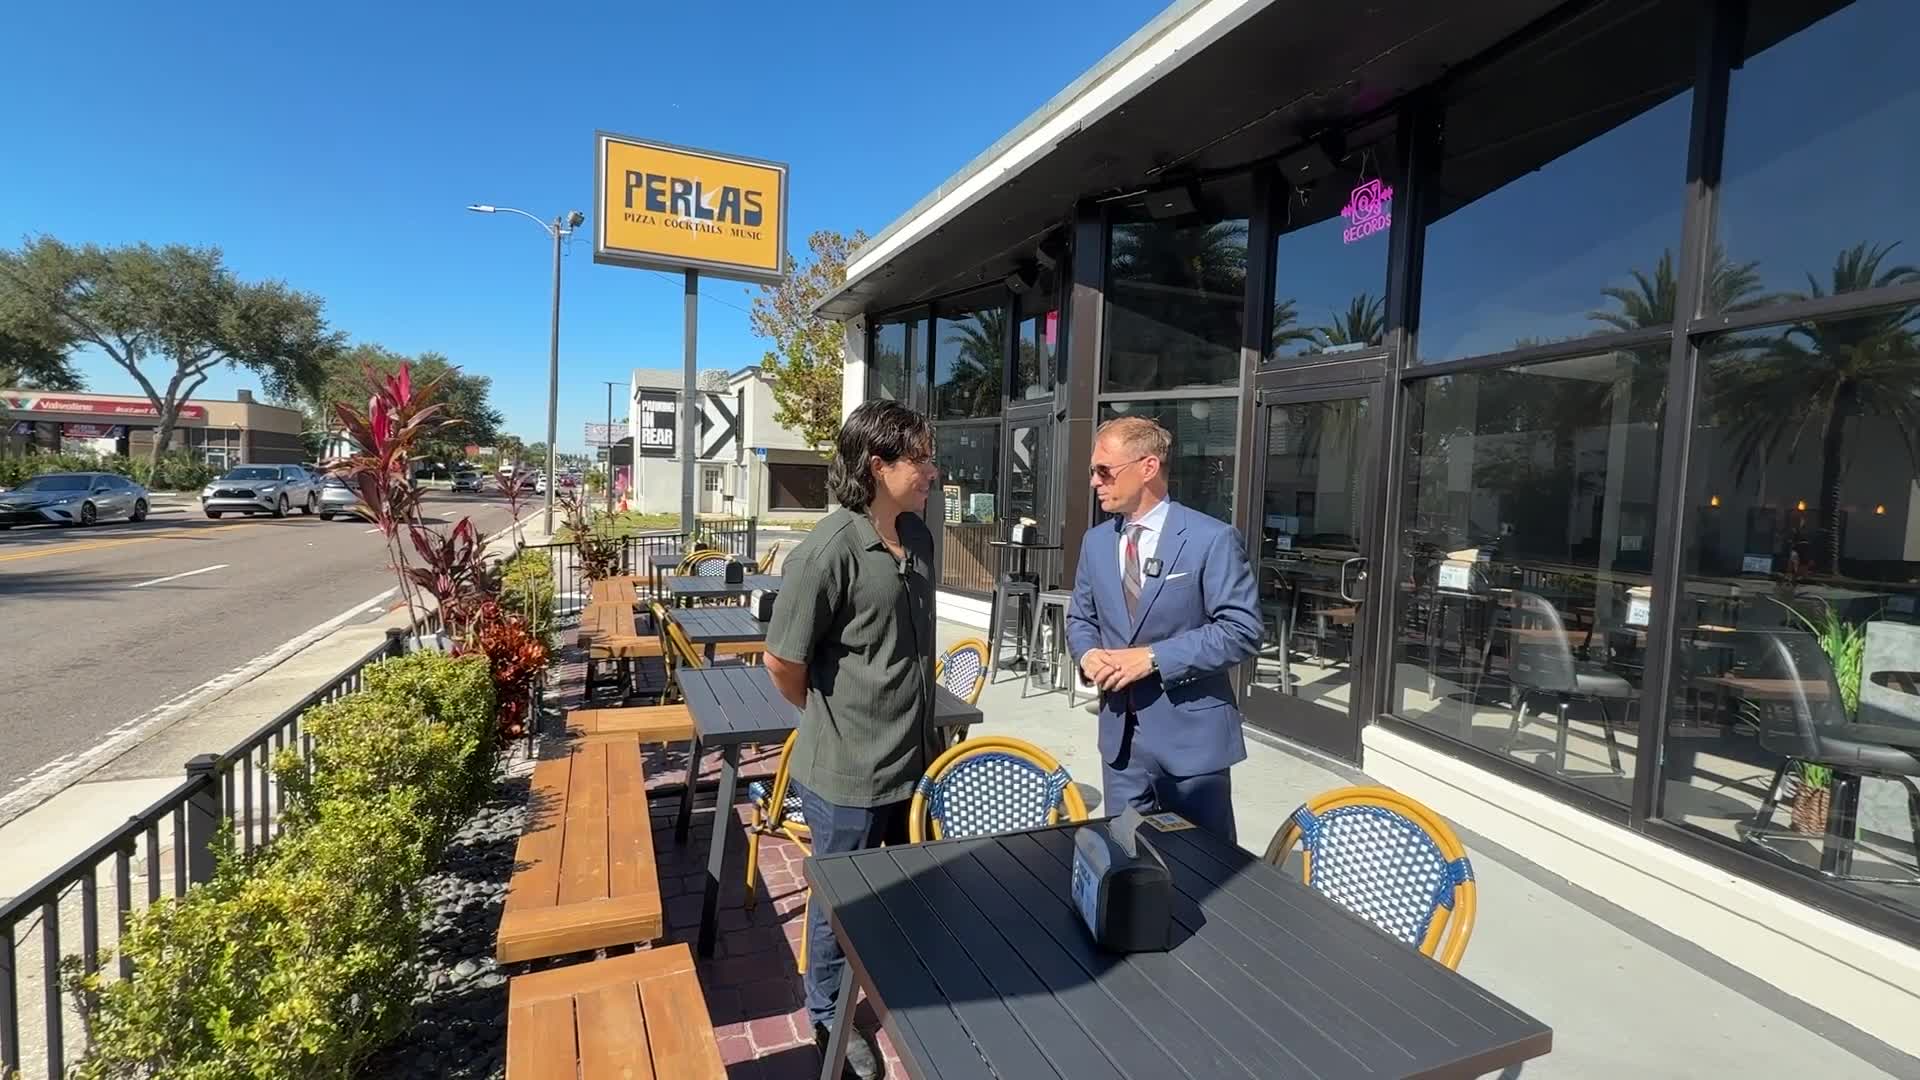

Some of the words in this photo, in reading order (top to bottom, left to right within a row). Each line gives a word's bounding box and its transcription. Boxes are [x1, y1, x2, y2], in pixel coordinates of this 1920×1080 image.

[625, 170, 762, 227] PERLAS
[624, 212, 656, 225] PIZZA
[664, 218, 722, 234] COCKTAILS
[730, 228, 762, 240] MUSIC
[1343, 213, 1392, 244] RECORDS
[40, 401, 94, 411] Valvoline
[641, 400, 675, 412] PARKING
[641, 411, 655, 428] IN
[641, 428, 673, 445] REAR
